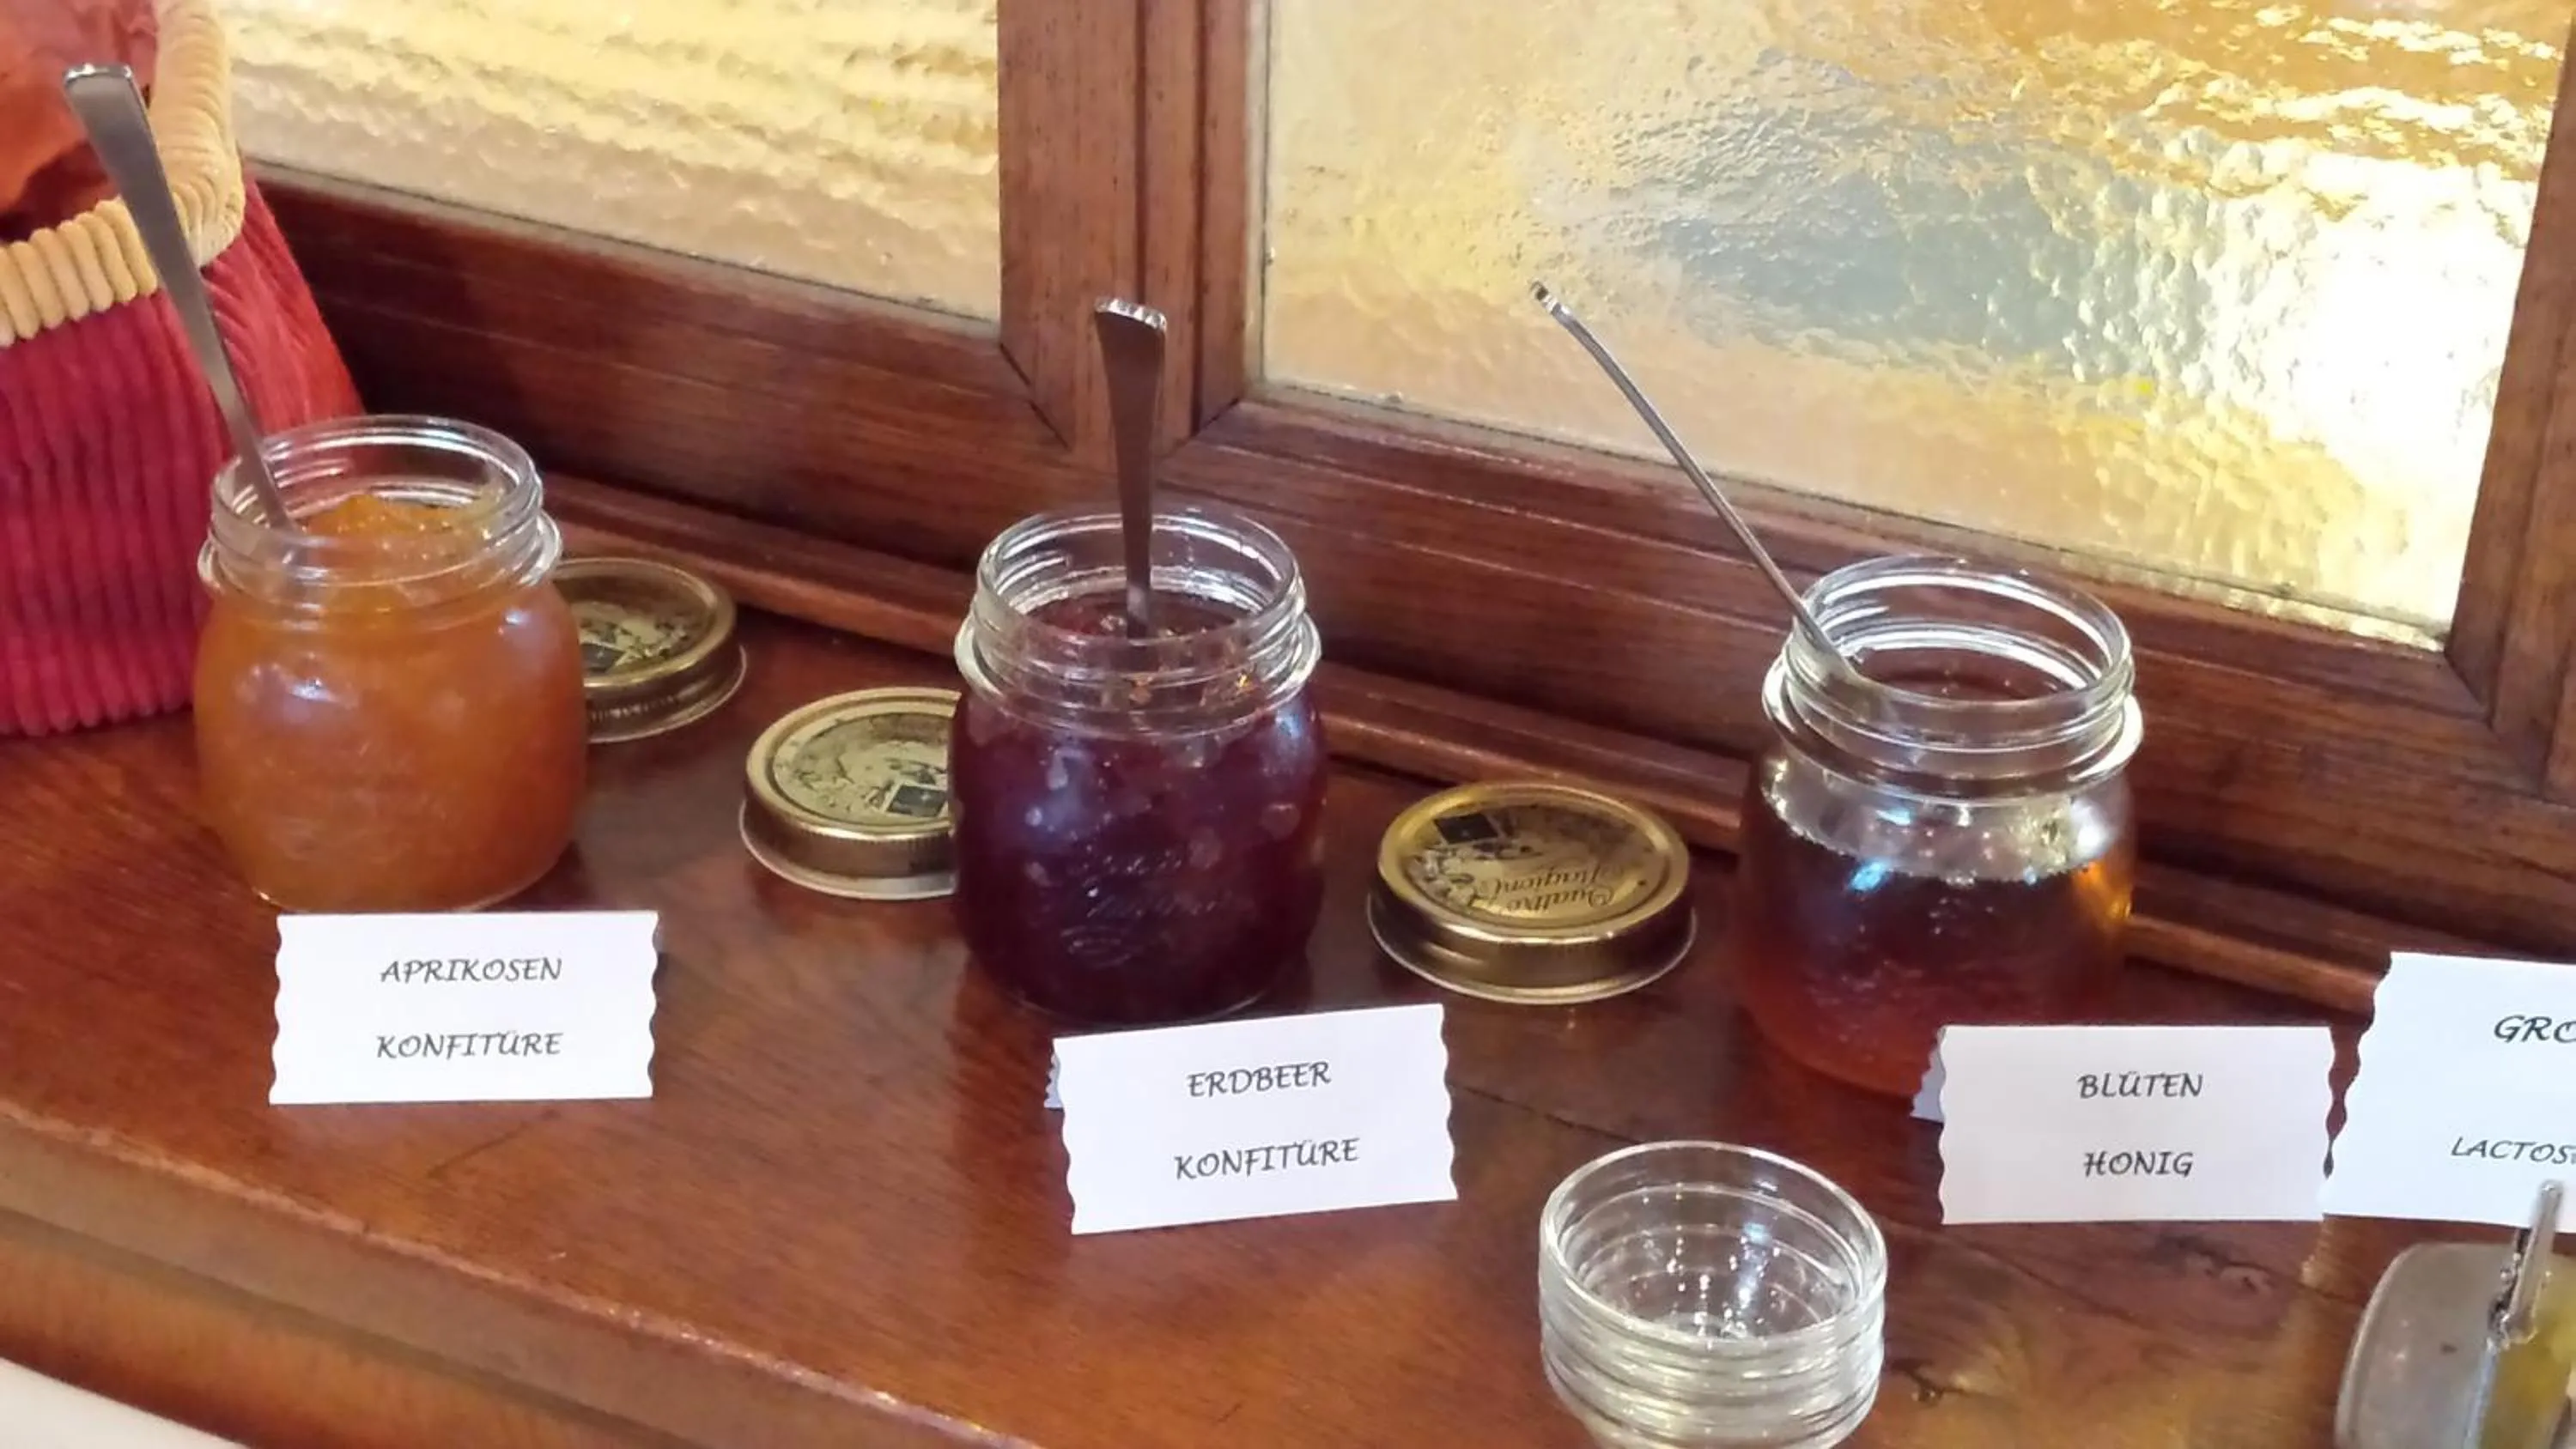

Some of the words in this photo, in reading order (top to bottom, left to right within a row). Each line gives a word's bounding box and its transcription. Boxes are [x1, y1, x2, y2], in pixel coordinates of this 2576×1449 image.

[380, 957, 563, 984] APRIKOSEN
[376, 1030, 564, 1059] KONFITÜRE
[1187, 1060, 1332, 1098] ERDBEER
[2076, 1070, 2203, 1100] BLÜTEN
[1174, 1137, 1361, 1180] KONFITÜRE
[2083, 1151, 2195, 1179] HONIG
[2451, 1136, 2576, 1166] LACTOS
